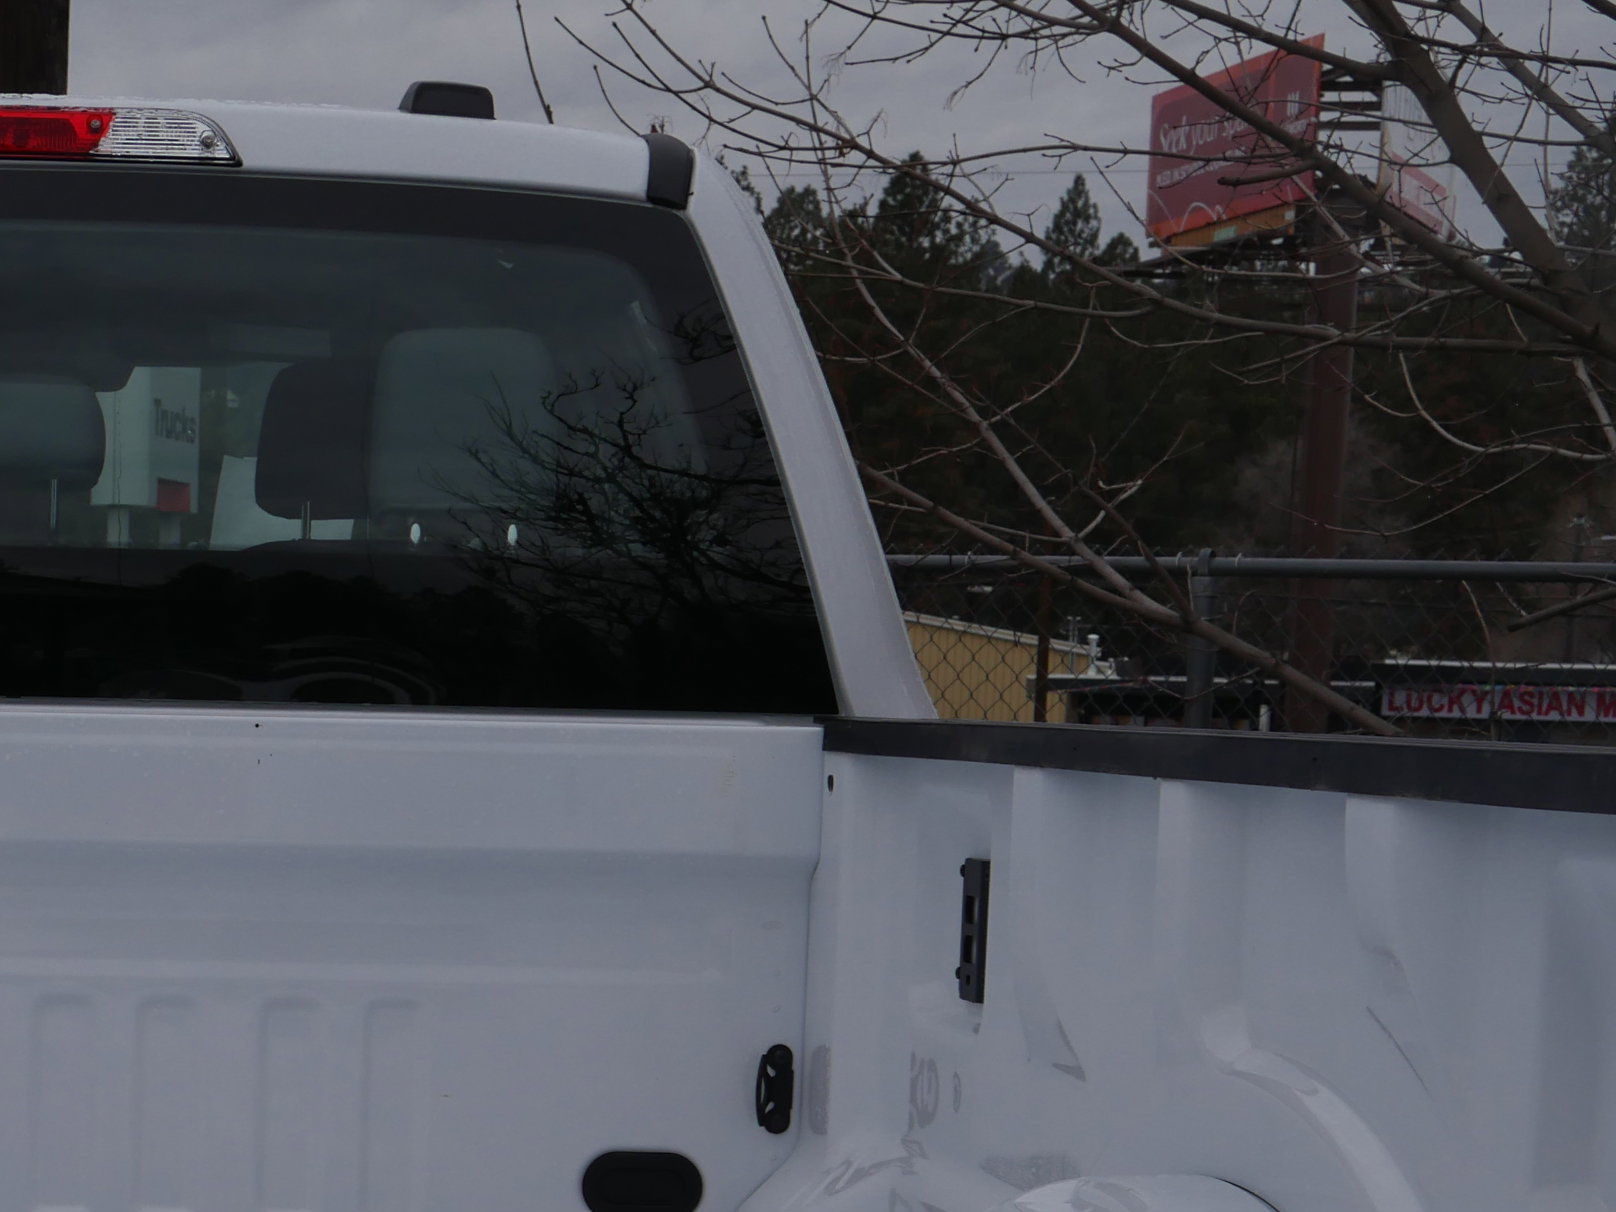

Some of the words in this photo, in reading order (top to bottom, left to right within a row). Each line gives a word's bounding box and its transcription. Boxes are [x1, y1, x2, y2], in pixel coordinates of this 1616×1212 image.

[153, 398, 197, 445] Trucks
[1386, 685, 1490, 715] LUCKY
[1497, 686, 1586, 717] ASIAN
